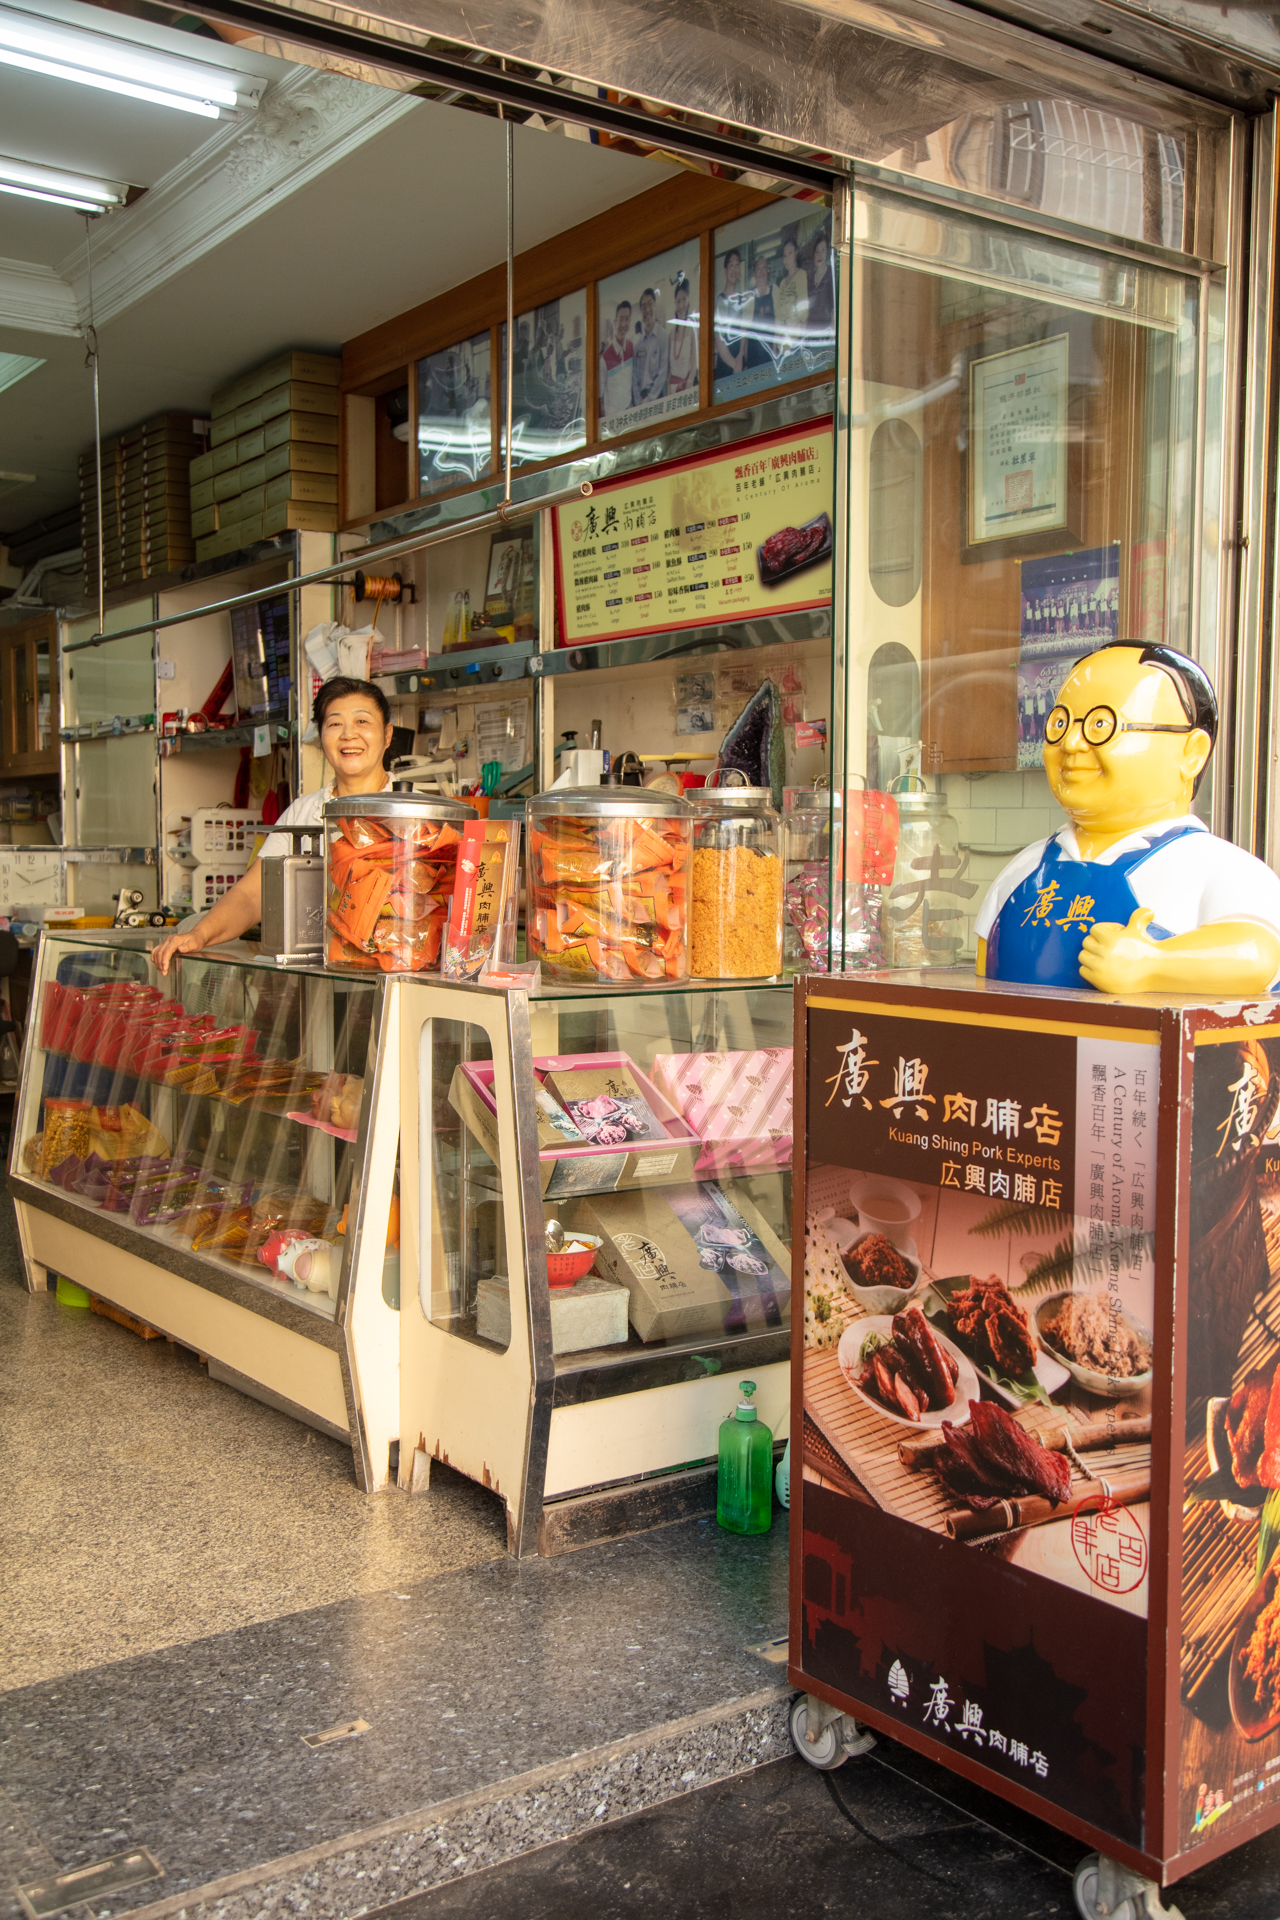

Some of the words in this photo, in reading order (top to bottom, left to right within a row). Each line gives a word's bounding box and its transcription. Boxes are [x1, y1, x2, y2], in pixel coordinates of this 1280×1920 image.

[740, 512, 751, 521] 150
[742, 541, 752, 551] 150
[15, 855, 21, 865] 11
[28, 855, 35, 865] 12
[44, 855, 47, 865] 1
[2, 864, 10, 874] 10
[53, 864, 59, 874] 2
[3, 878, 9, 888] 9
[54, 879, 59, 888] 3
[3, 893, 9, 903] 8
[469, 861, 495, 935] 廣興肉脯店
[1020, 880, 1096, 933] 廣興
[1114, 1067, 1127, 1079] A
[825, 1028, 1064, 1146] 廣興肉脯店
[1110, 1084, 1127, 1149] Century
[889, 1127, 929, 1150] Kuang
[931, 1134, 969, 1158] Shing
[972, 1142, 1003, 1161] Pork
[1006, 1148, 1061, 1172] Experts
[1112, 1152, 1125, 1171] of
[940, 1160, 1063, 1210] 広興肉脯店
[1110, 1174, 1125, 1228] Aroma
[1107, 1297, 1122, 1344] Shing
[923, 1675, 1049, 1778] 廣興肉脯店
